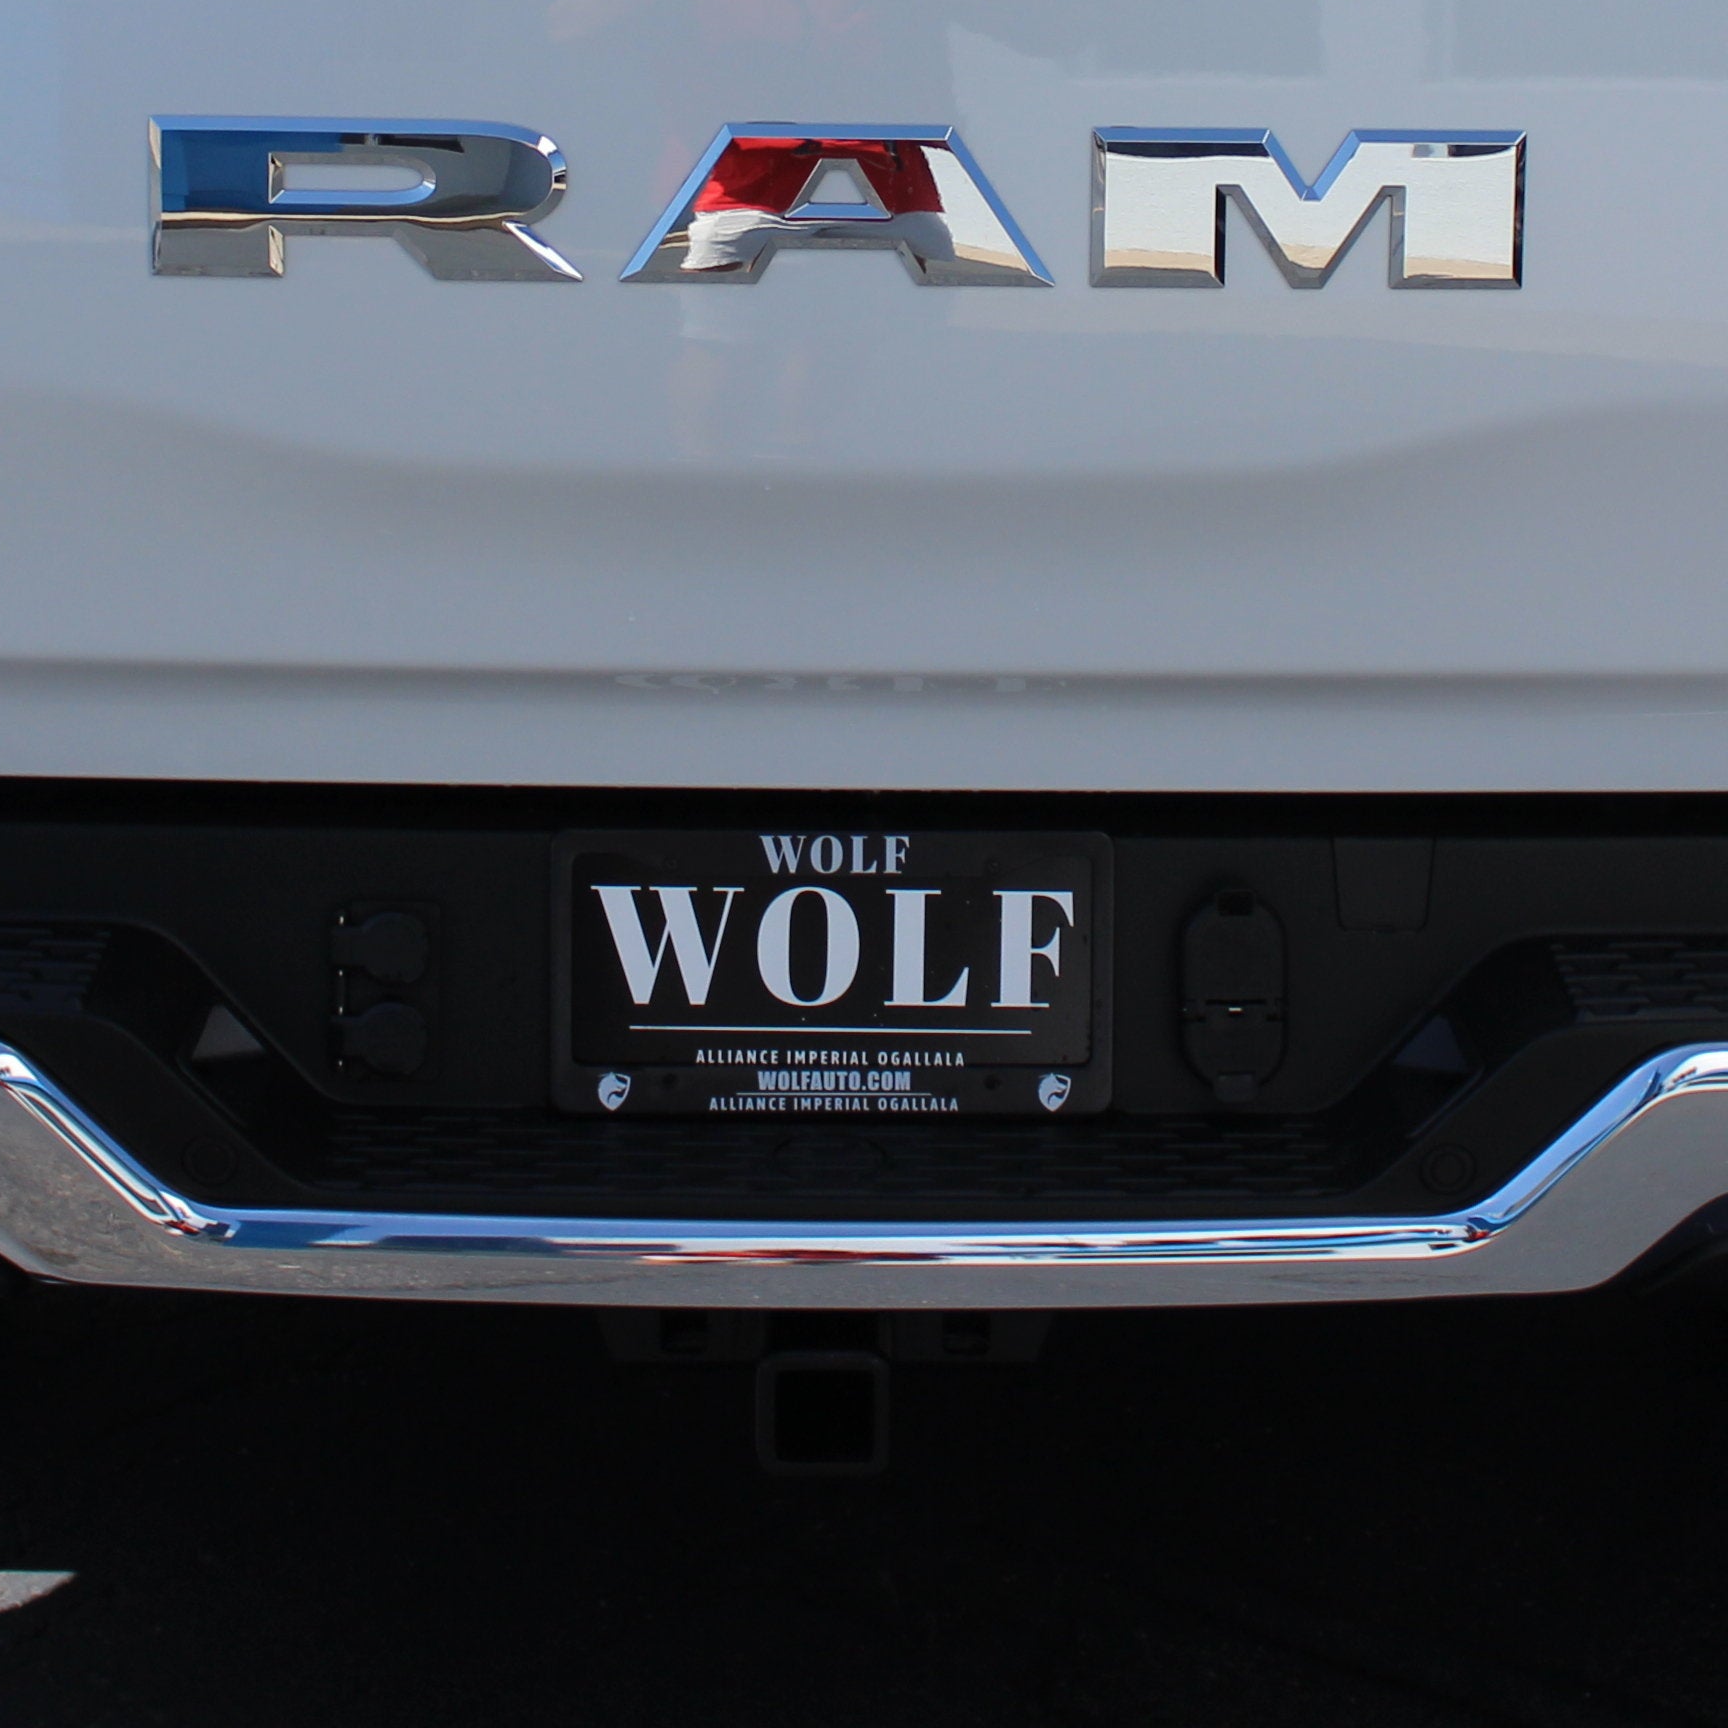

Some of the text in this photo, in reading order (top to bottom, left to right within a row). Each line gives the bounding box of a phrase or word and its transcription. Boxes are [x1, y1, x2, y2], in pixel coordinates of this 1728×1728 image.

[148, 115, 1528, 288] RAM
[759, 835, 910, 874] WOLF
[590, 884, 1075, 1009] WOLF
[696, 1049, 965, 1067] ALLIANCE IMPERIAL OGALLALA
[757, 1070, 911, 1091] WOLFAUTO.COM
[709, 1097, 959, 1112] ALLIANCE IMPERIAL OGALLALA
